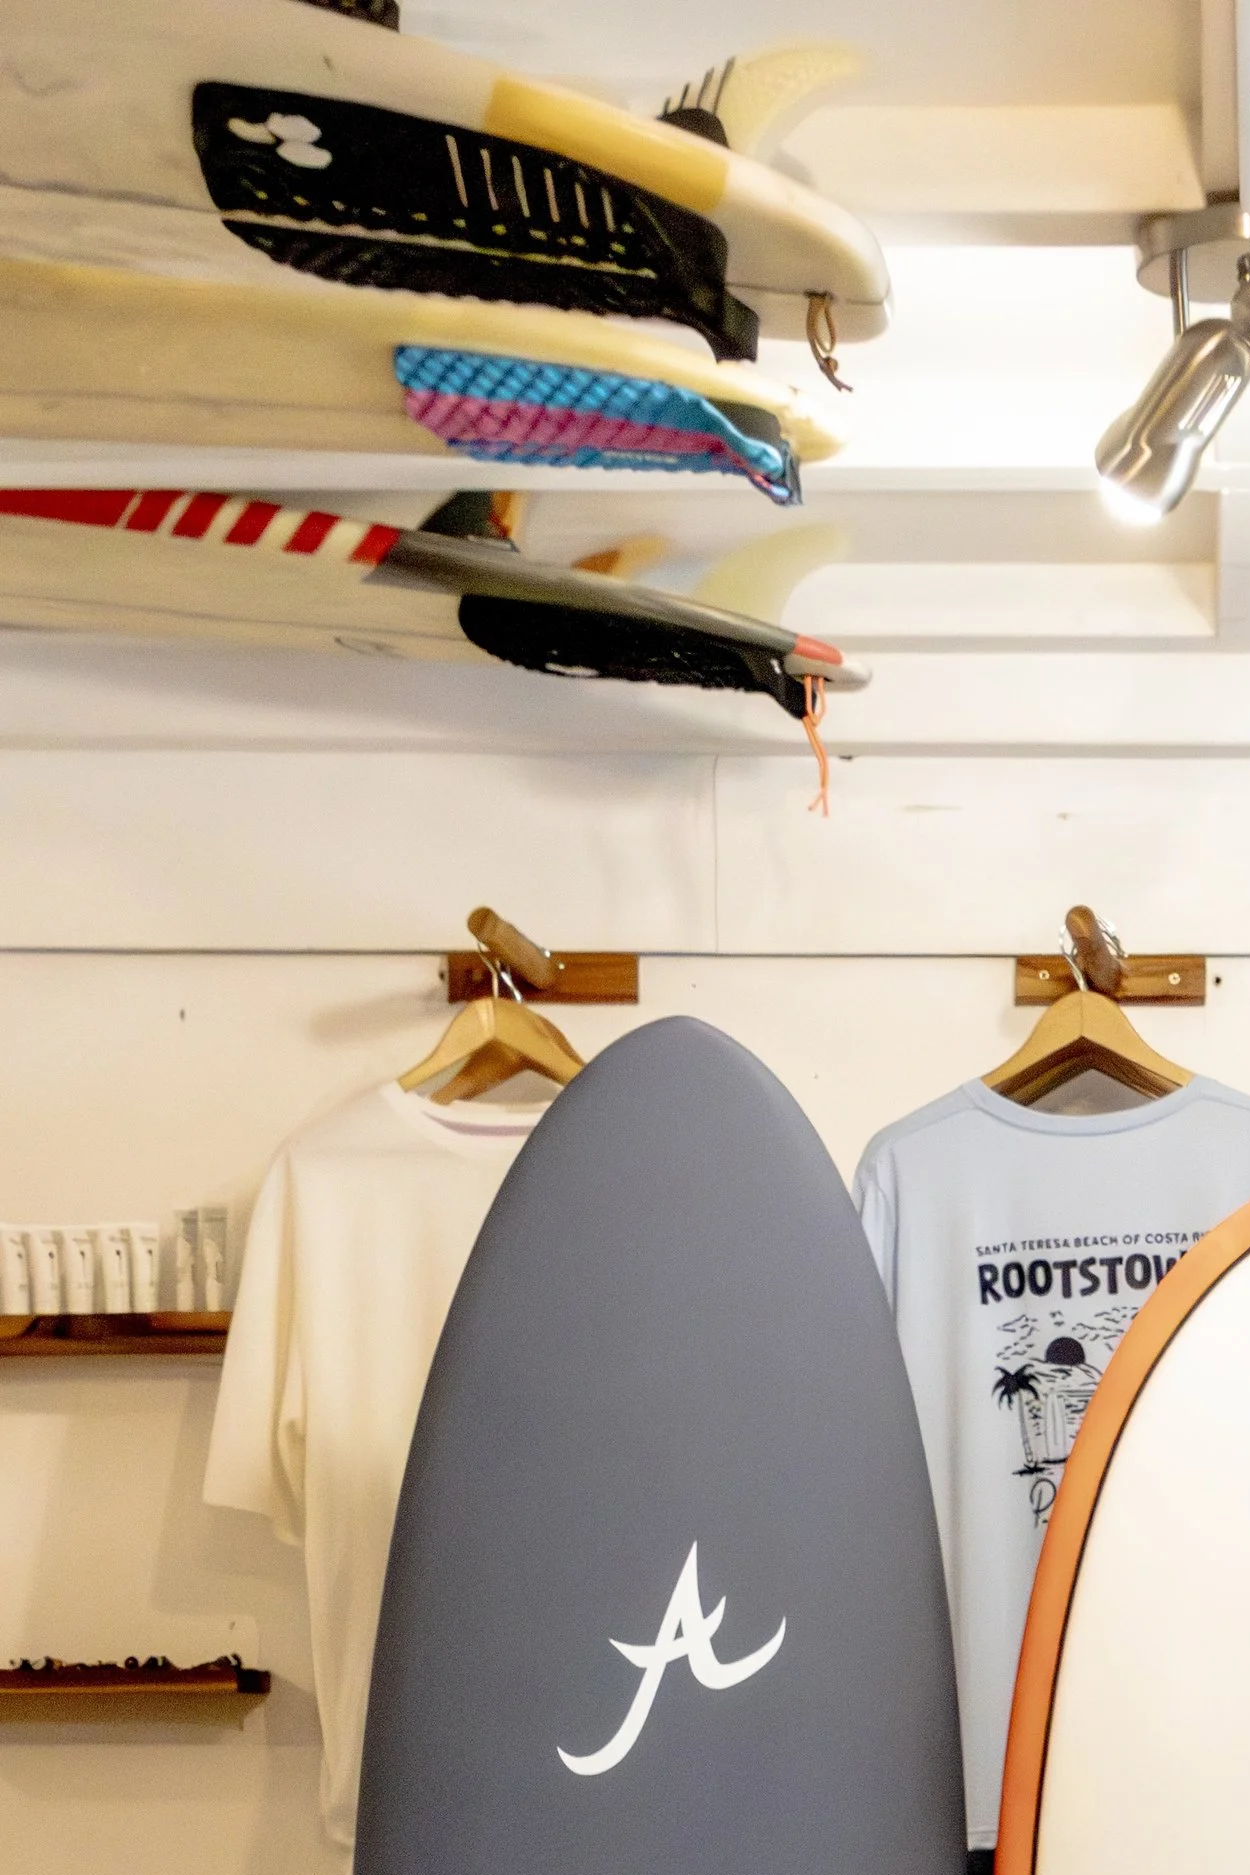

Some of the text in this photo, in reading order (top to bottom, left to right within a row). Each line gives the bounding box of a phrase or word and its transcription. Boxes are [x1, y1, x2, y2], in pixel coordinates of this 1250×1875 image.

[976, 1242, 1017, 1257] SANTA
[1021, 1238, 1070, 1251] TERESA
[1074, 1235, 1118, 1248] BEACH
[1123, 1234, 1140, 1244] OF
[1145, 1232, 1188, 1244] COSTA
